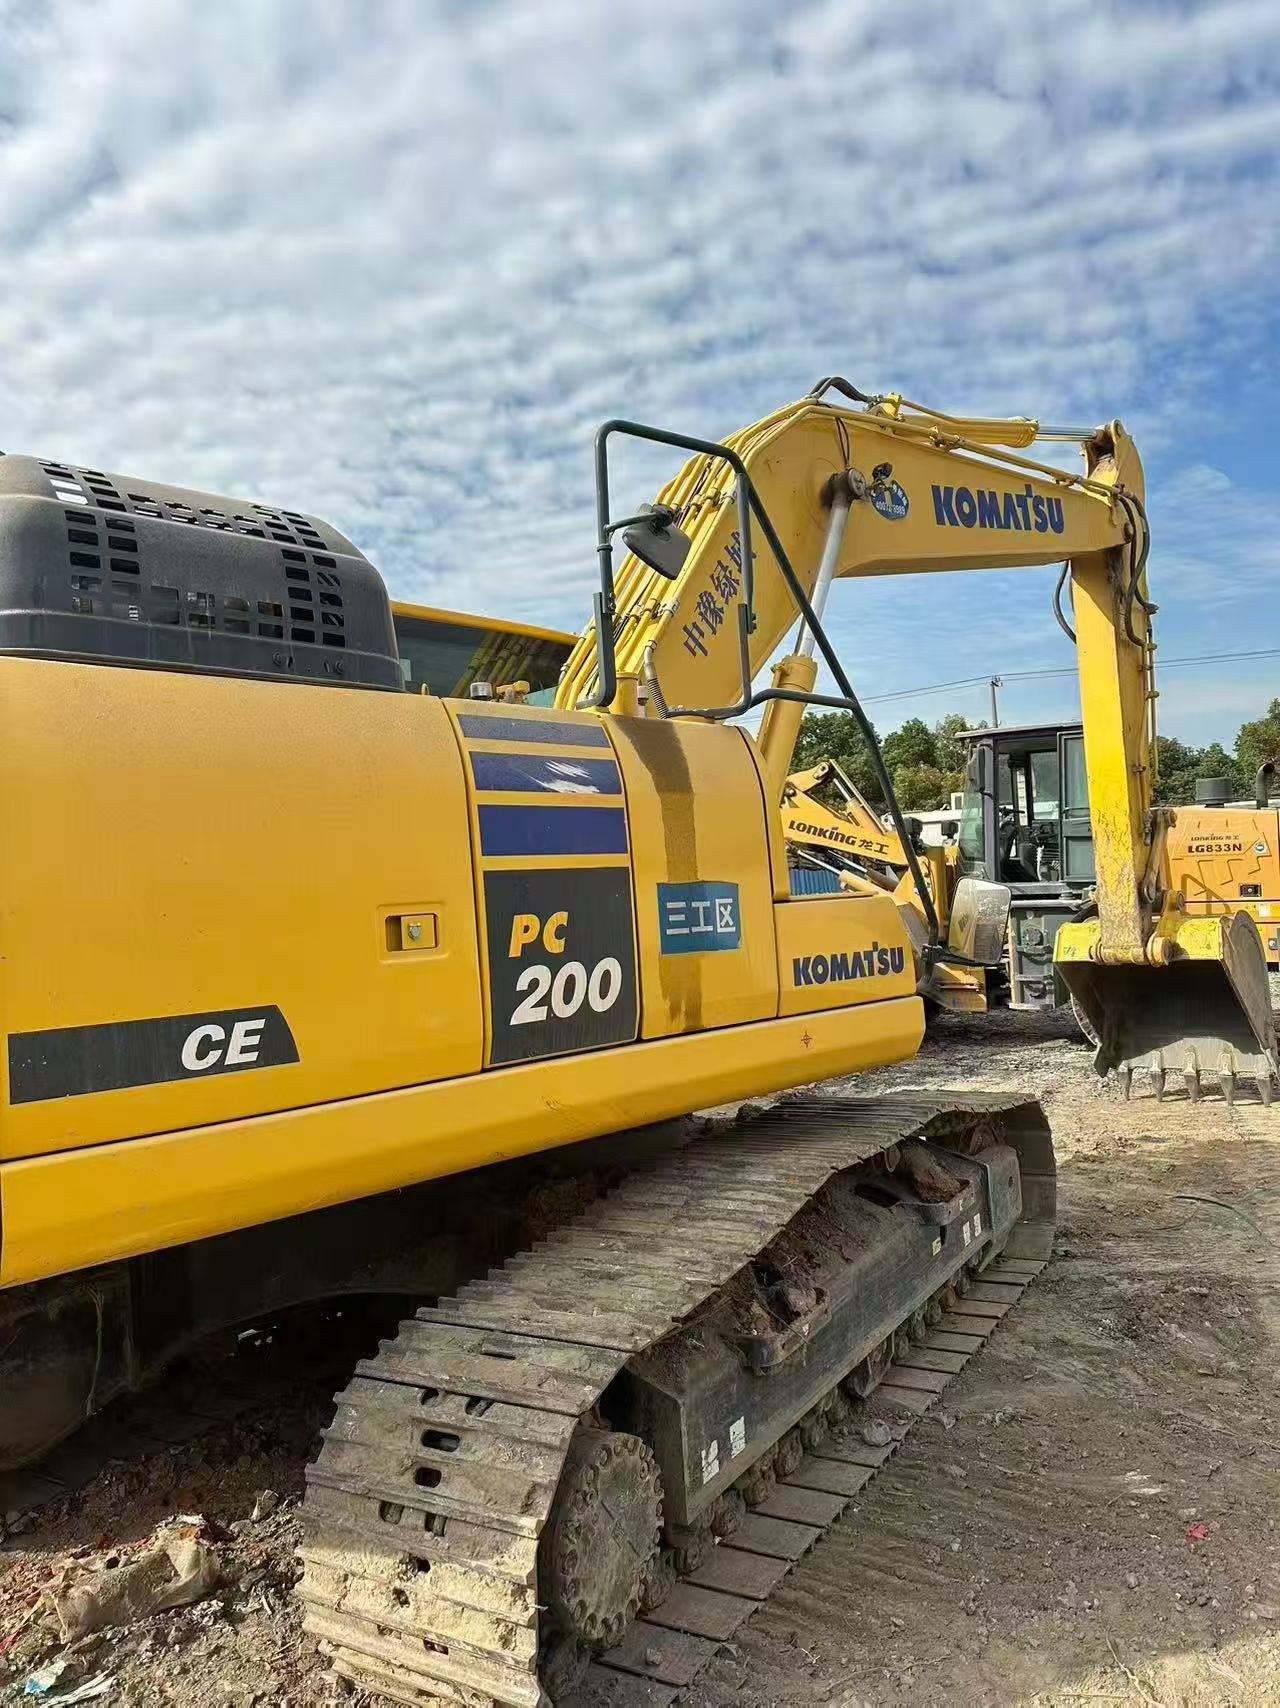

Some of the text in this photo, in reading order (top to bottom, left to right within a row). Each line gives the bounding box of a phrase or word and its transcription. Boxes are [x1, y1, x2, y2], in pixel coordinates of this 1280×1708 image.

[931, 484, 1064, 534] KOMATSU
[1188, 843, 1242, 854] LG833N
[508, 911, 569, 958] PC
[666, 898, 736, 936] 三工区
[793, 941, 904, 987] KOMATSU
[509, 957, 622, 1026] 200
[182, 1018, 266, 1071] CE
